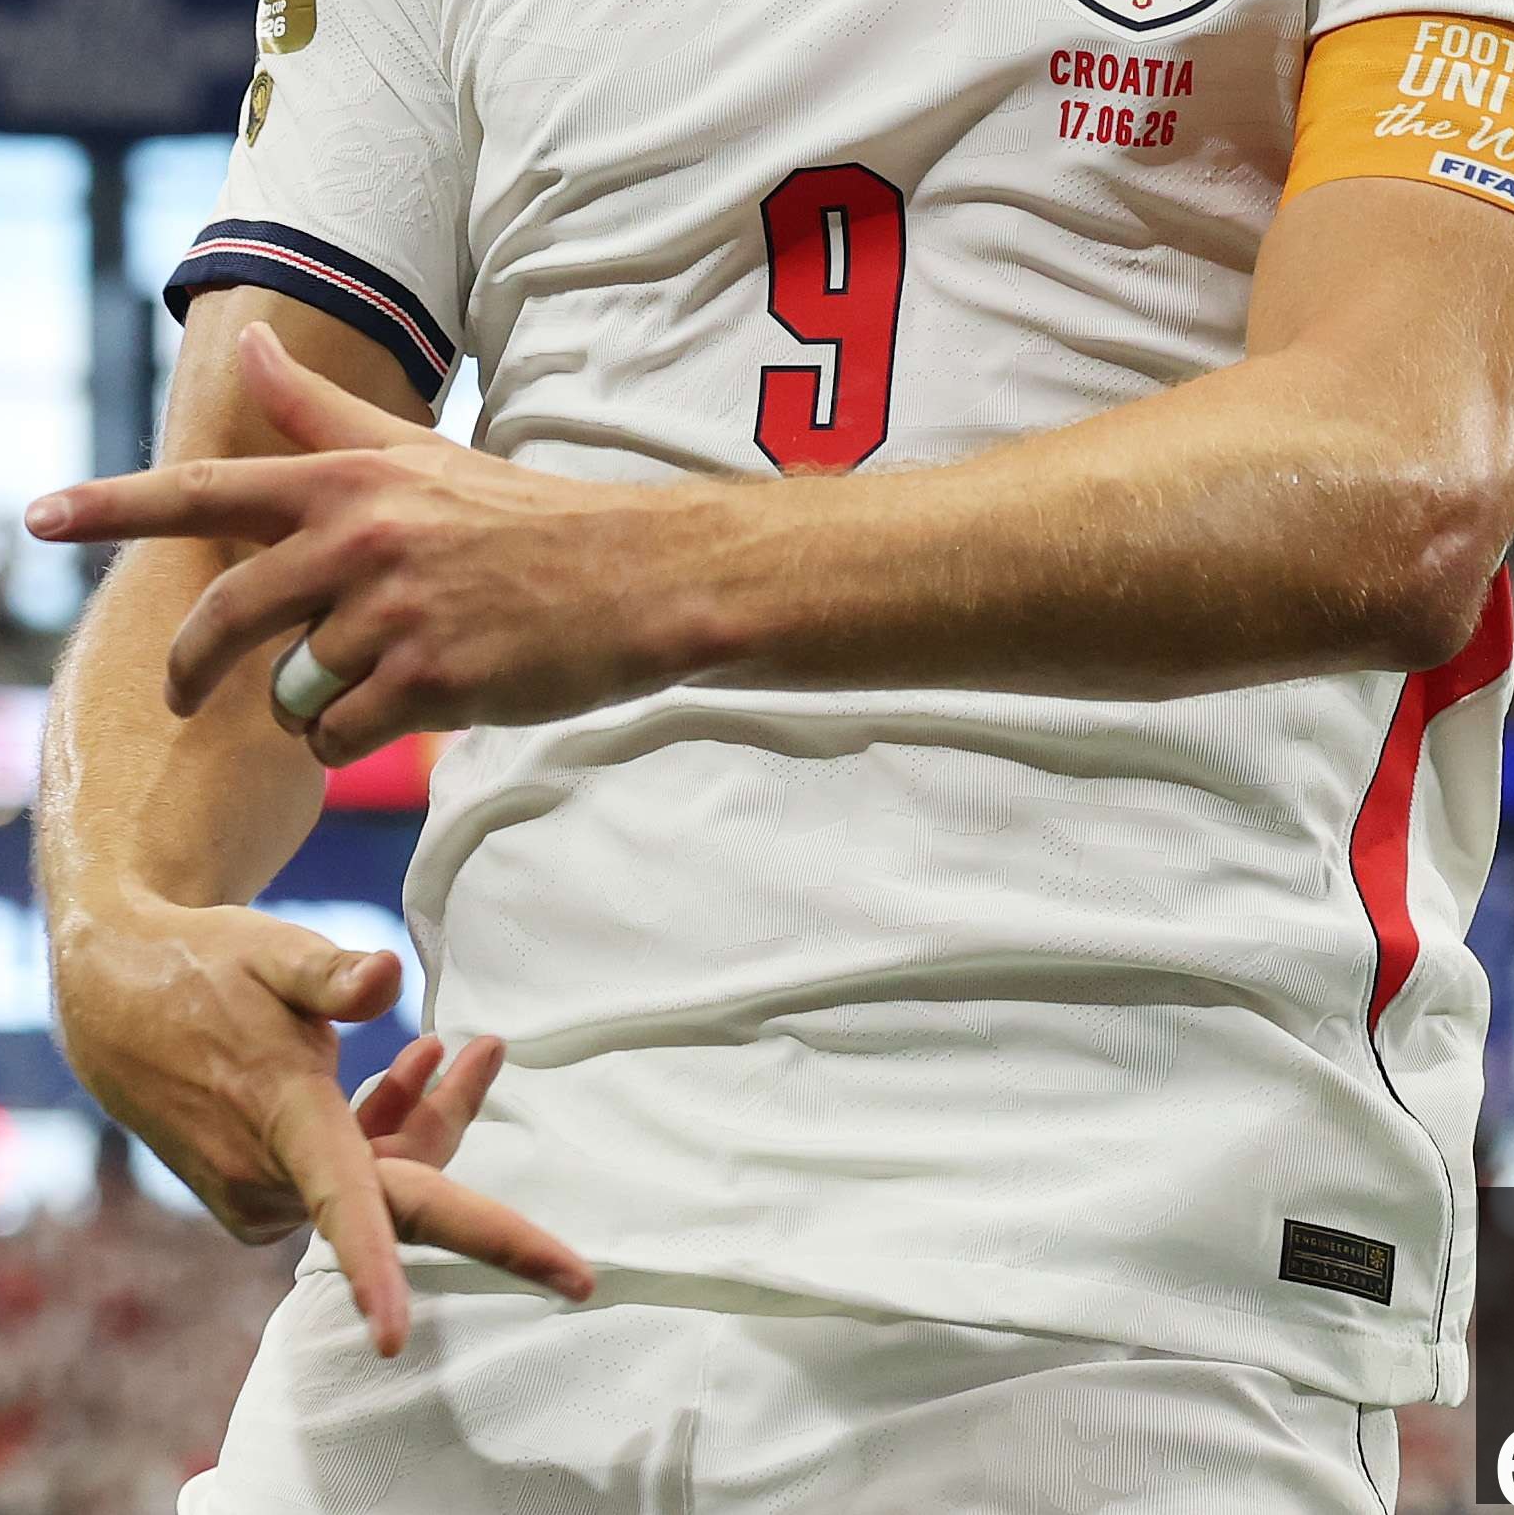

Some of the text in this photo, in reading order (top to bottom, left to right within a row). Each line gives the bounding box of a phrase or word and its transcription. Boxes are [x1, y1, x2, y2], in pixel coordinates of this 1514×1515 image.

[1050, 49, 1193, 97] CROATIA
[1059, 100, 1177, 147] 17.06.26
[1375, 101, 1461, 139] the
[753, 162, 906, 477] 9
